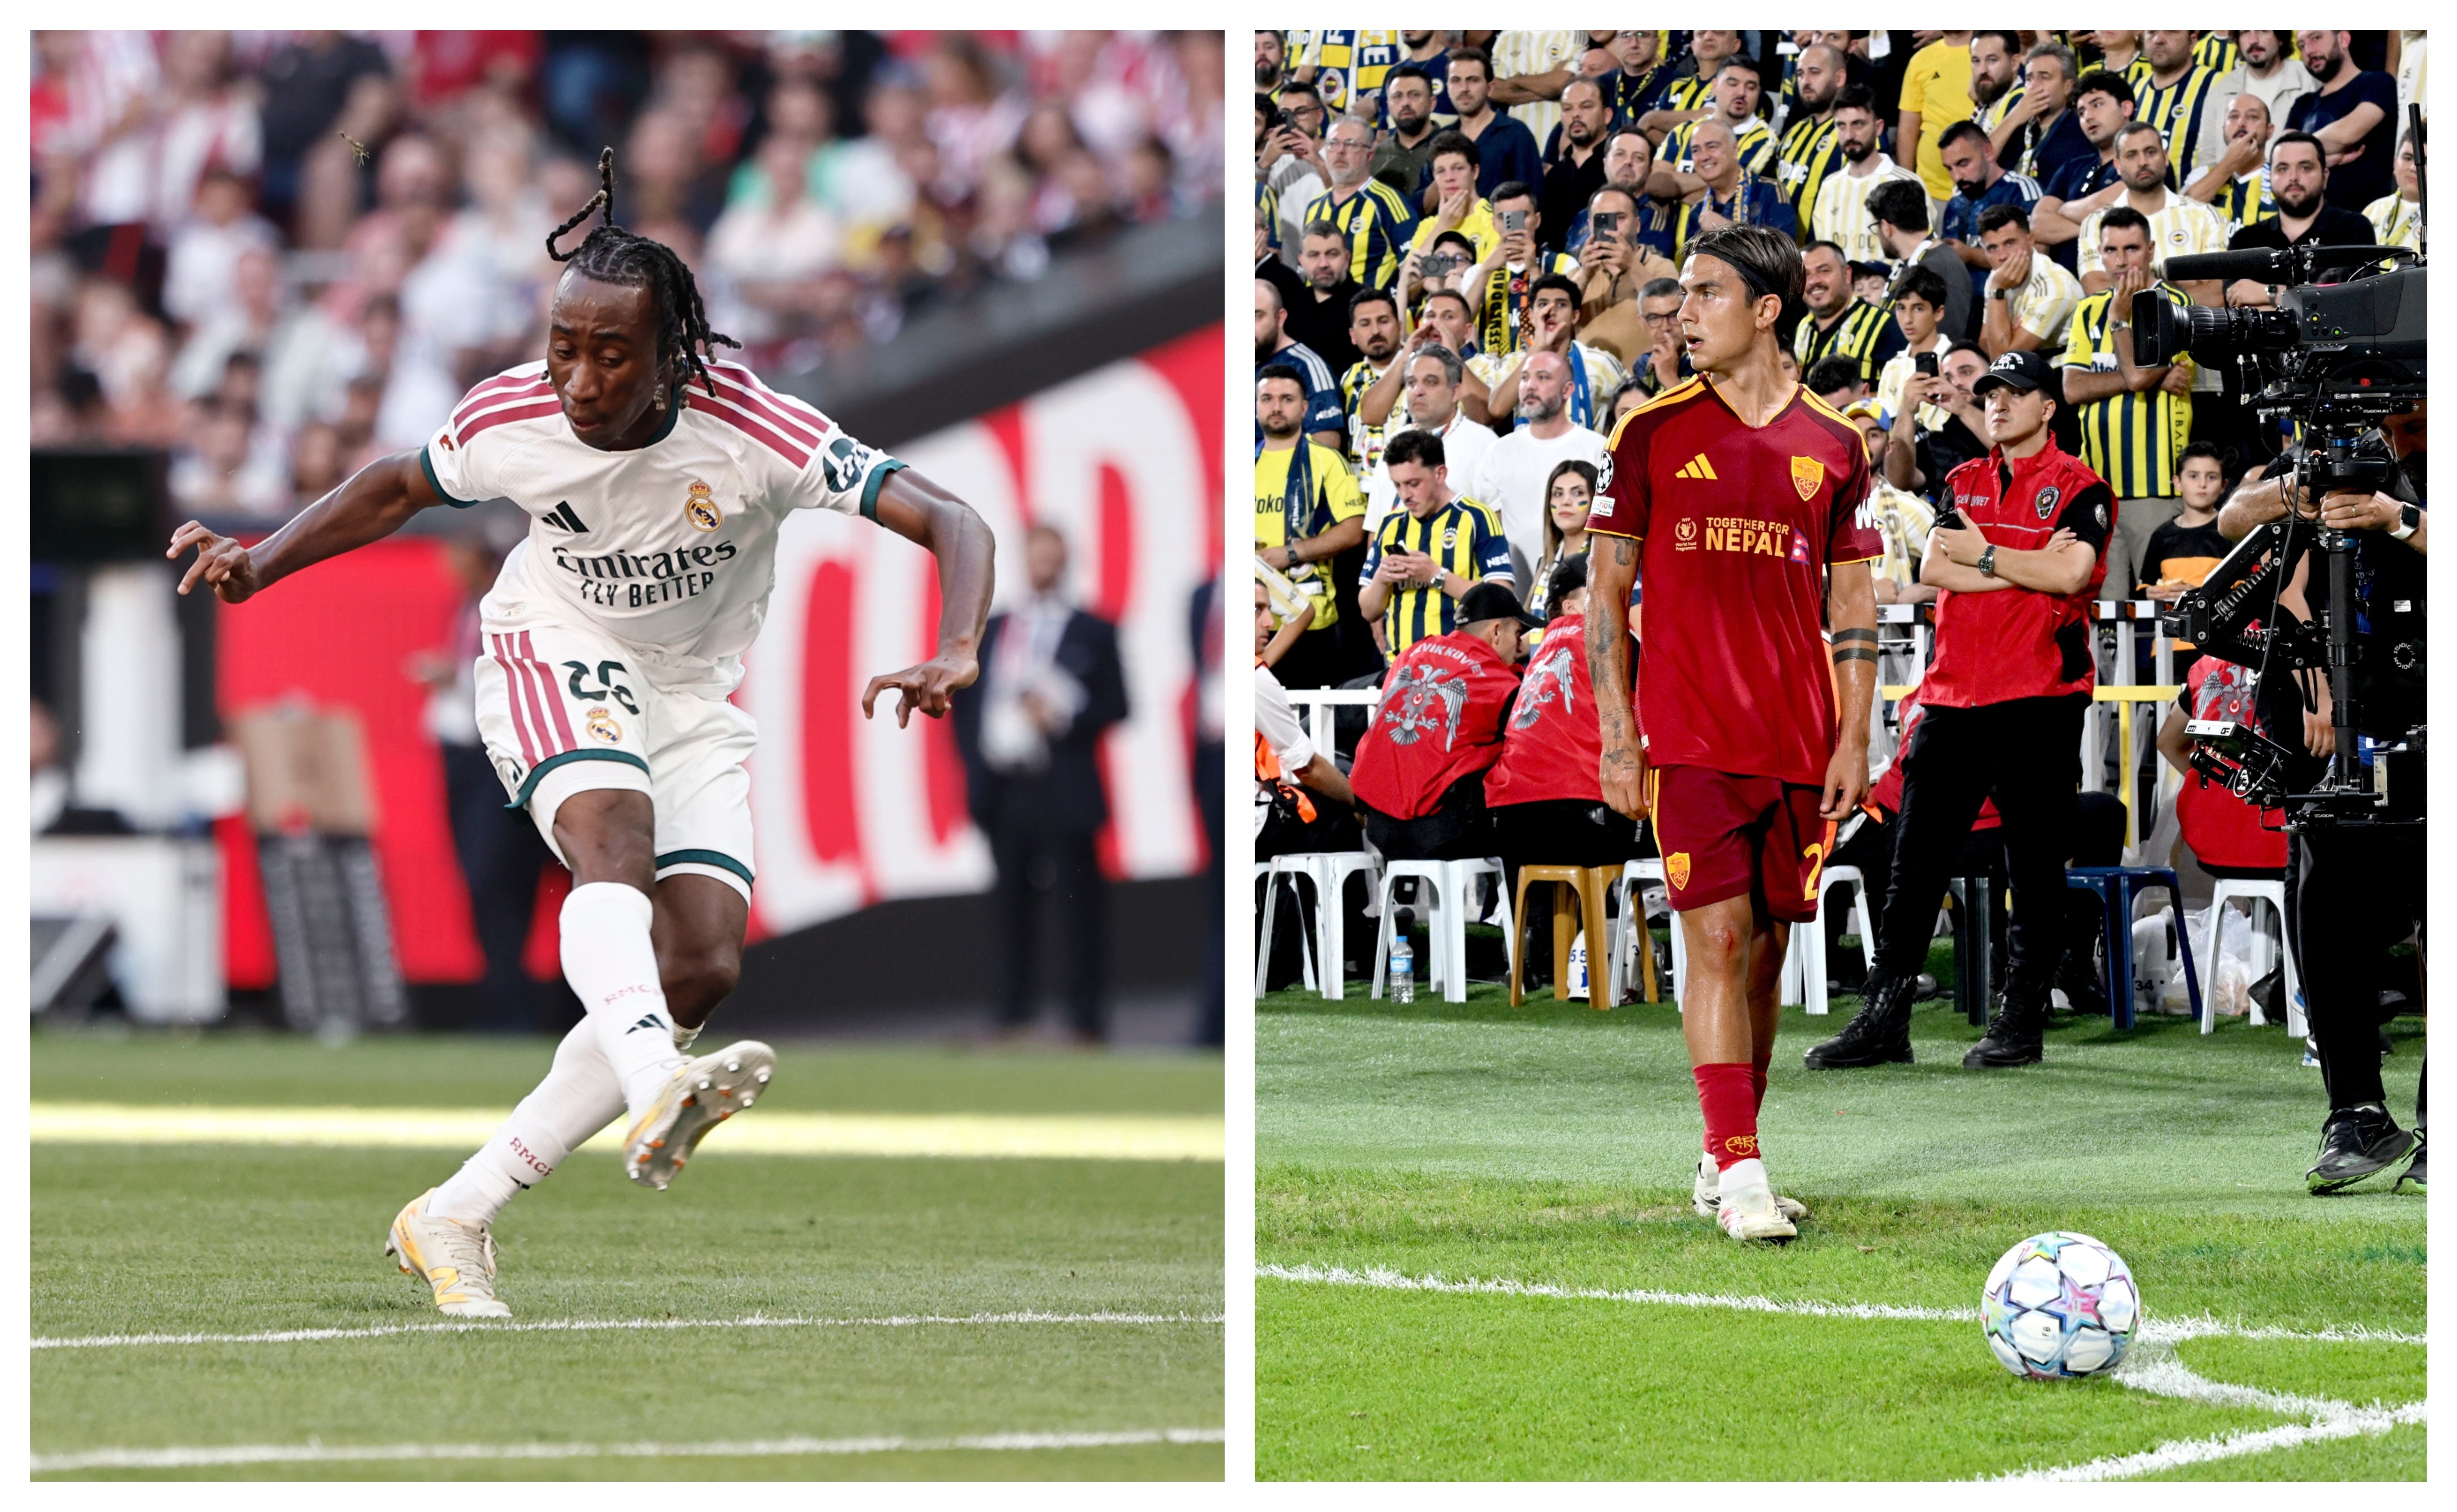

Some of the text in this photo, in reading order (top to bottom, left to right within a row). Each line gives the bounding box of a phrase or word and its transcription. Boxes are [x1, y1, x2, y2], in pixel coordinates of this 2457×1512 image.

[1255, 494, 1284, 514] oko
[1706, 517, 1789, 535] TOGETHER FOR
[1706, 528, 1786, 558] NEPAL
[552, 540, 737, 580] Emirates
[629, 570, 714, 608] BETTER
[559, 659, 641, 716] 26
[1803, 843, 1822, 901] 2
[2135, 979, 2154, 991] 34
